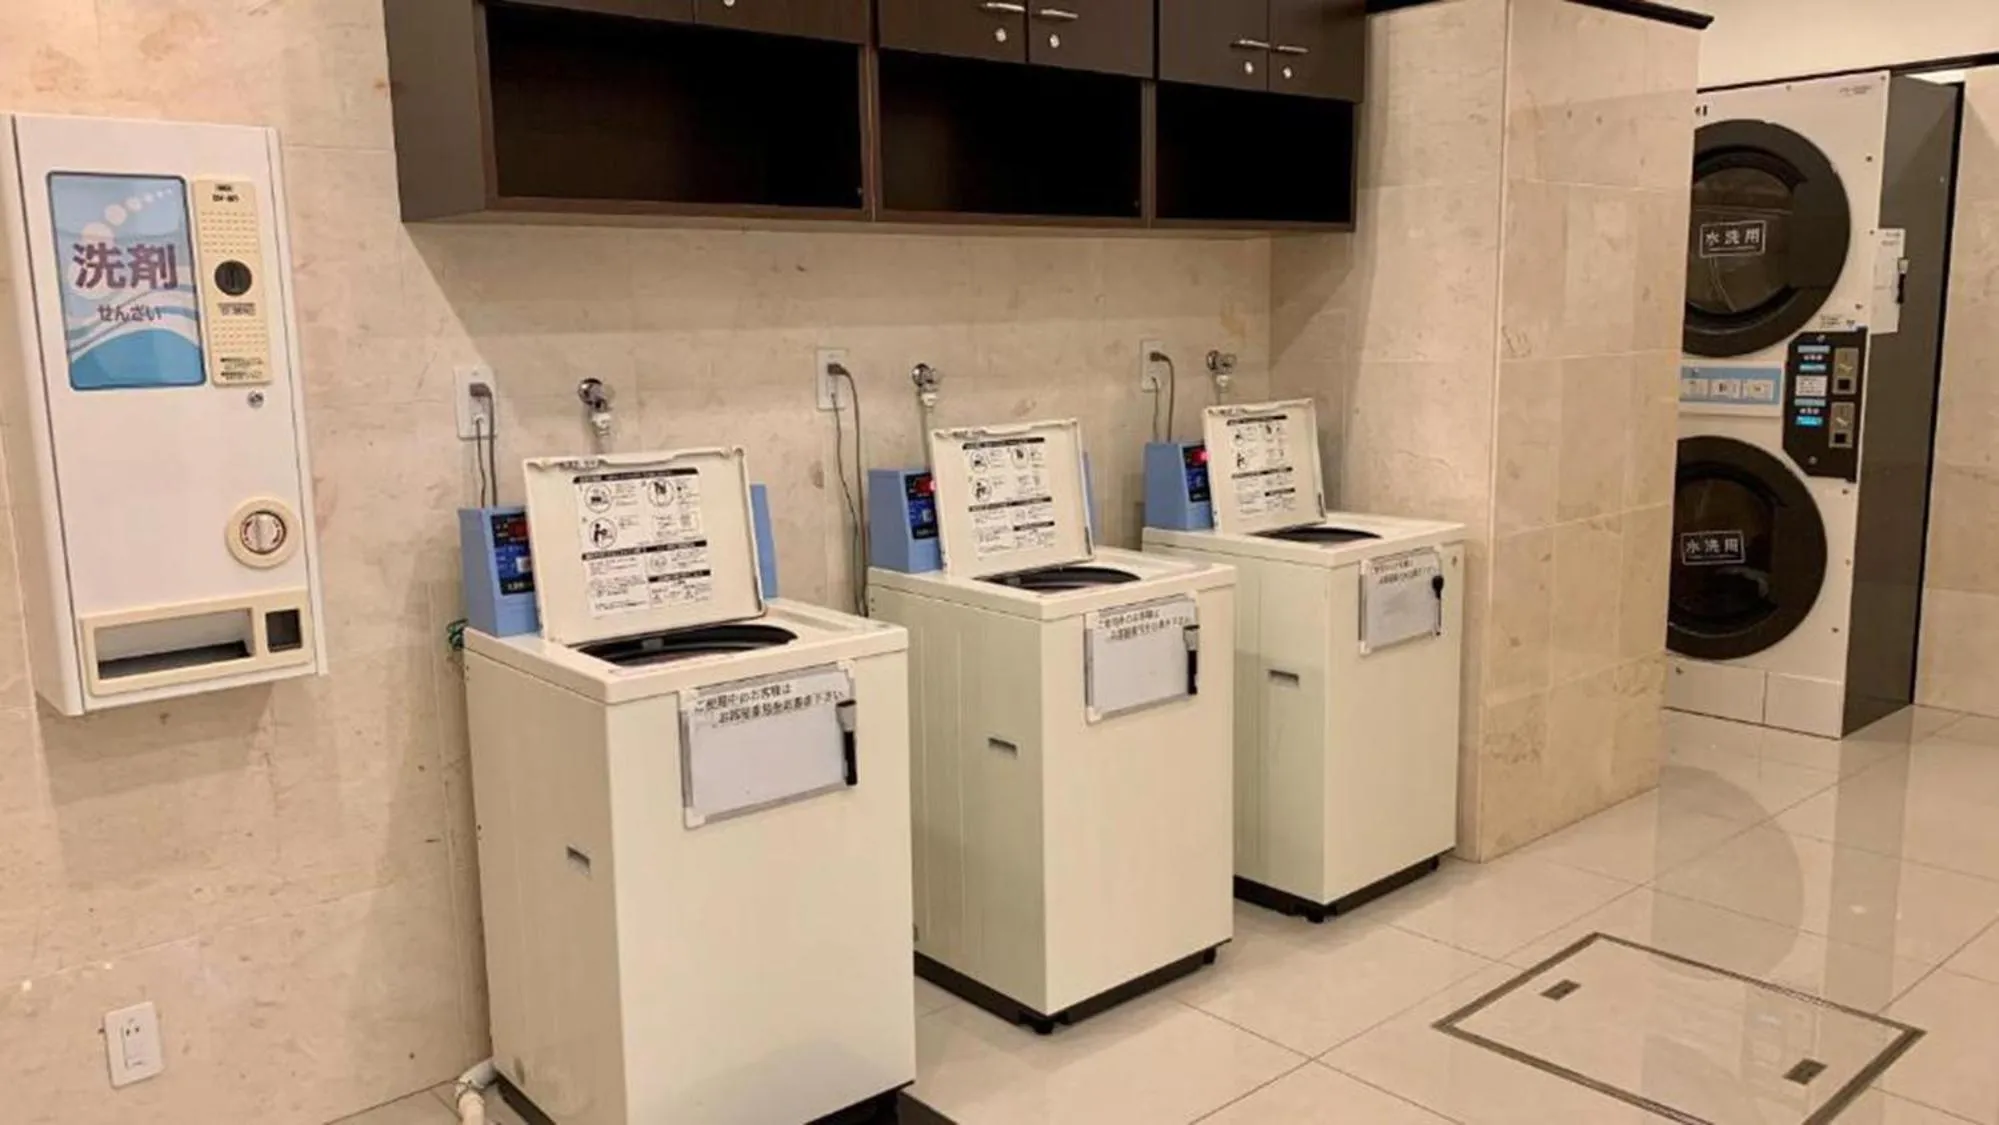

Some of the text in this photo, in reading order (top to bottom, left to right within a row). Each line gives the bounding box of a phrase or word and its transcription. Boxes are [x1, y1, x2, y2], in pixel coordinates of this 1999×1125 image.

[1704, 228, 1761, 246] 水洗用
[72, 242, 178, 290] 洗剤
[98, 304, 162, 322] せんざい
[1685, 538, 1740, 554] 水洗用
